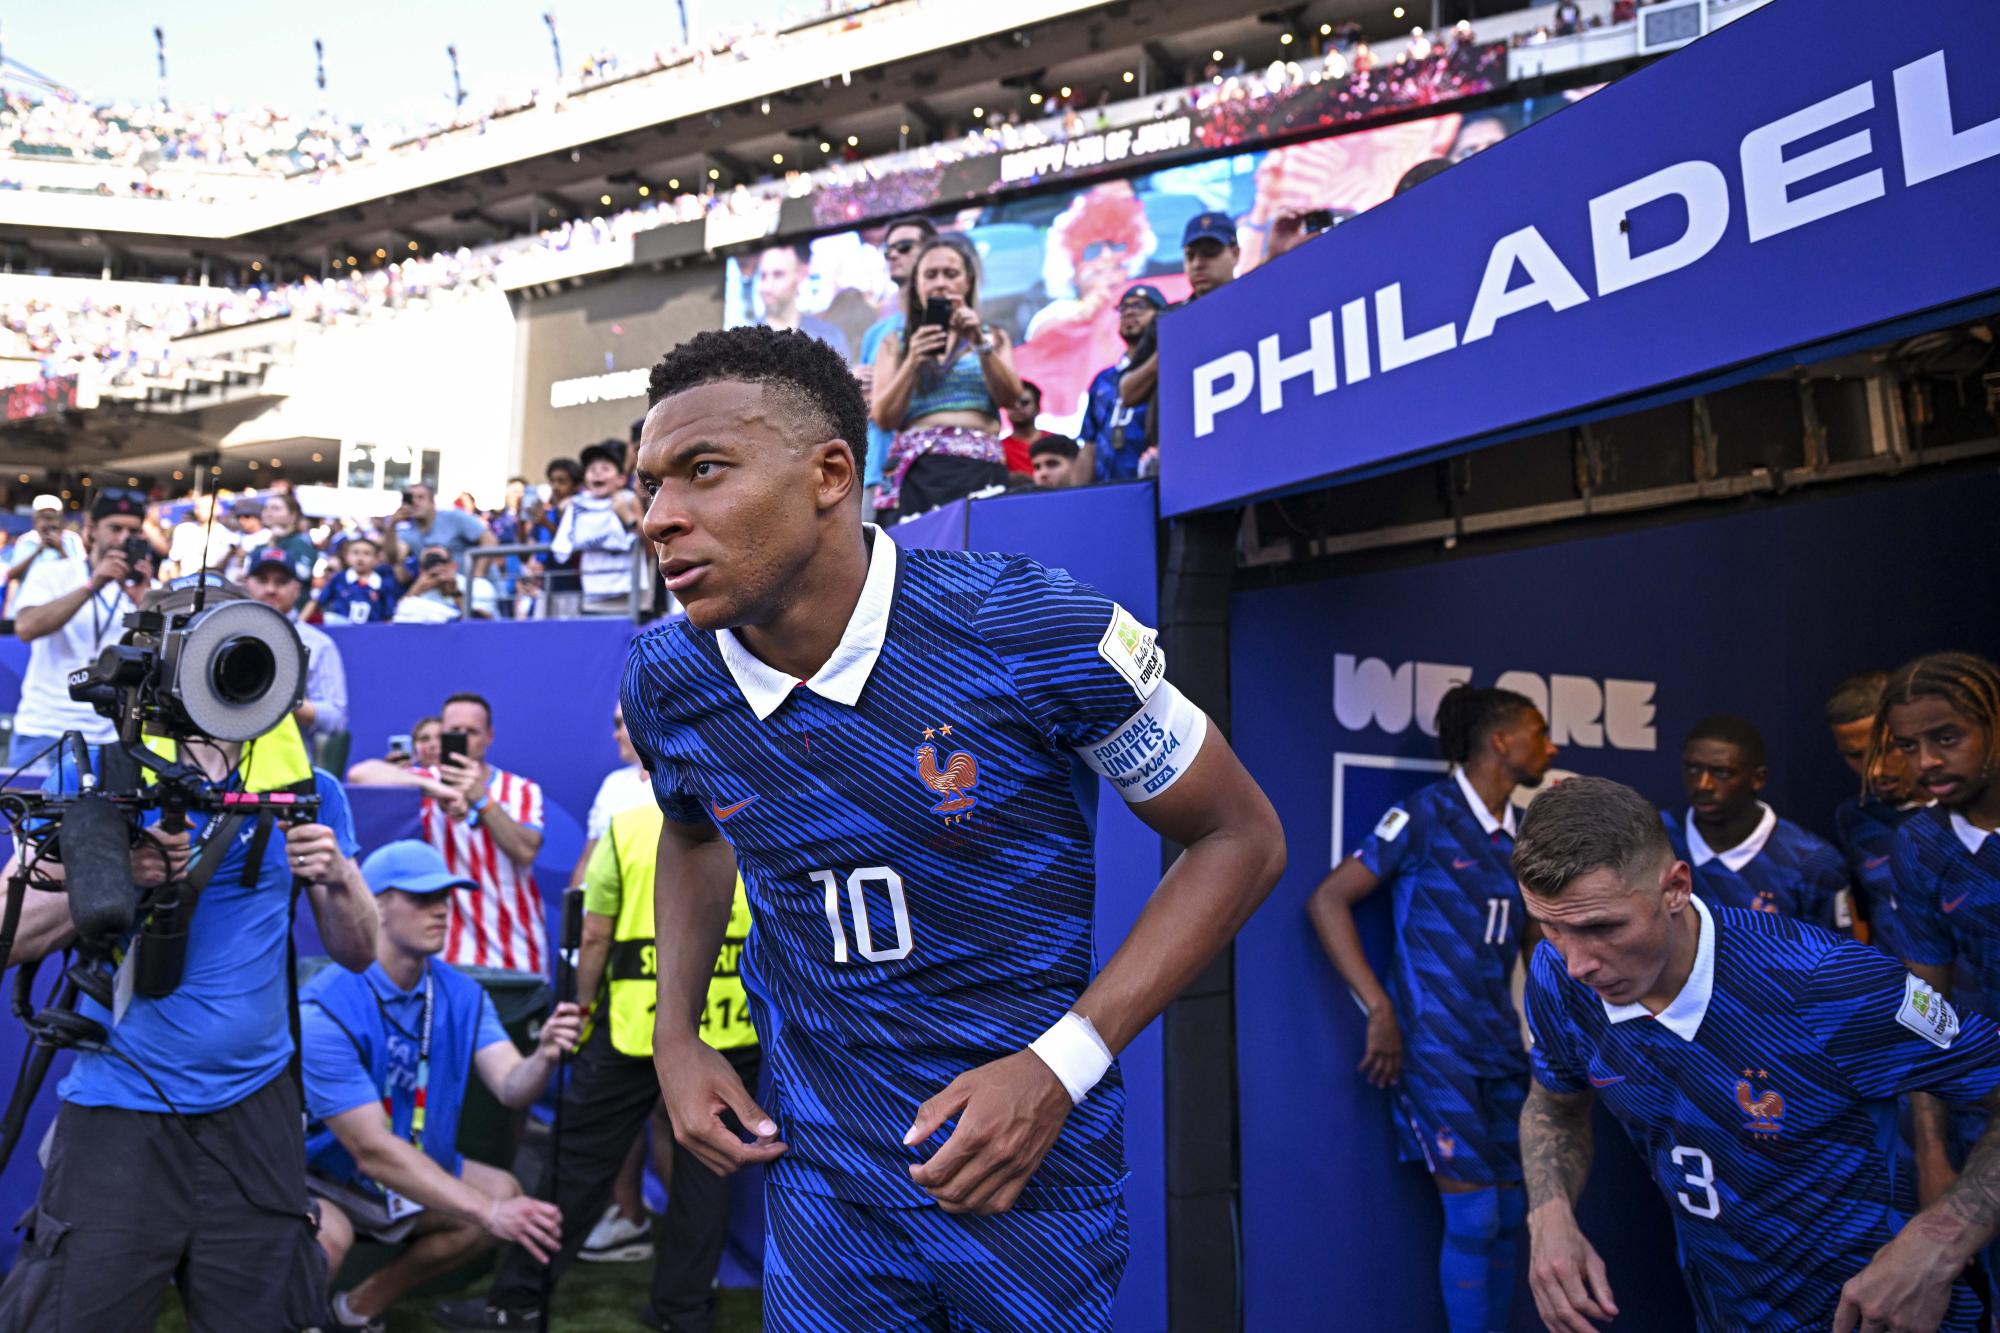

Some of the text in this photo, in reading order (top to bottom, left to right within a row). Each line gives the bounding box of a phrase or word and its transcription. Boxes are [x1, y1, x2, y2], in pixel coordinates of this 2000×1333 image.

[1192, 48, 2000, 438] PHILADEL
[1093, 713, 1154, 761] FOOTBALL
[1102, 721, 1164, 776] UNITES
[1116, 731, 1180, 788] the World
[1146, 768, 1173, 791] FIFA
[808, 866, 914, 962] 10
[1484, 898, 1510, 944] 11
[1671, 1145, 1720, 1219] 3
